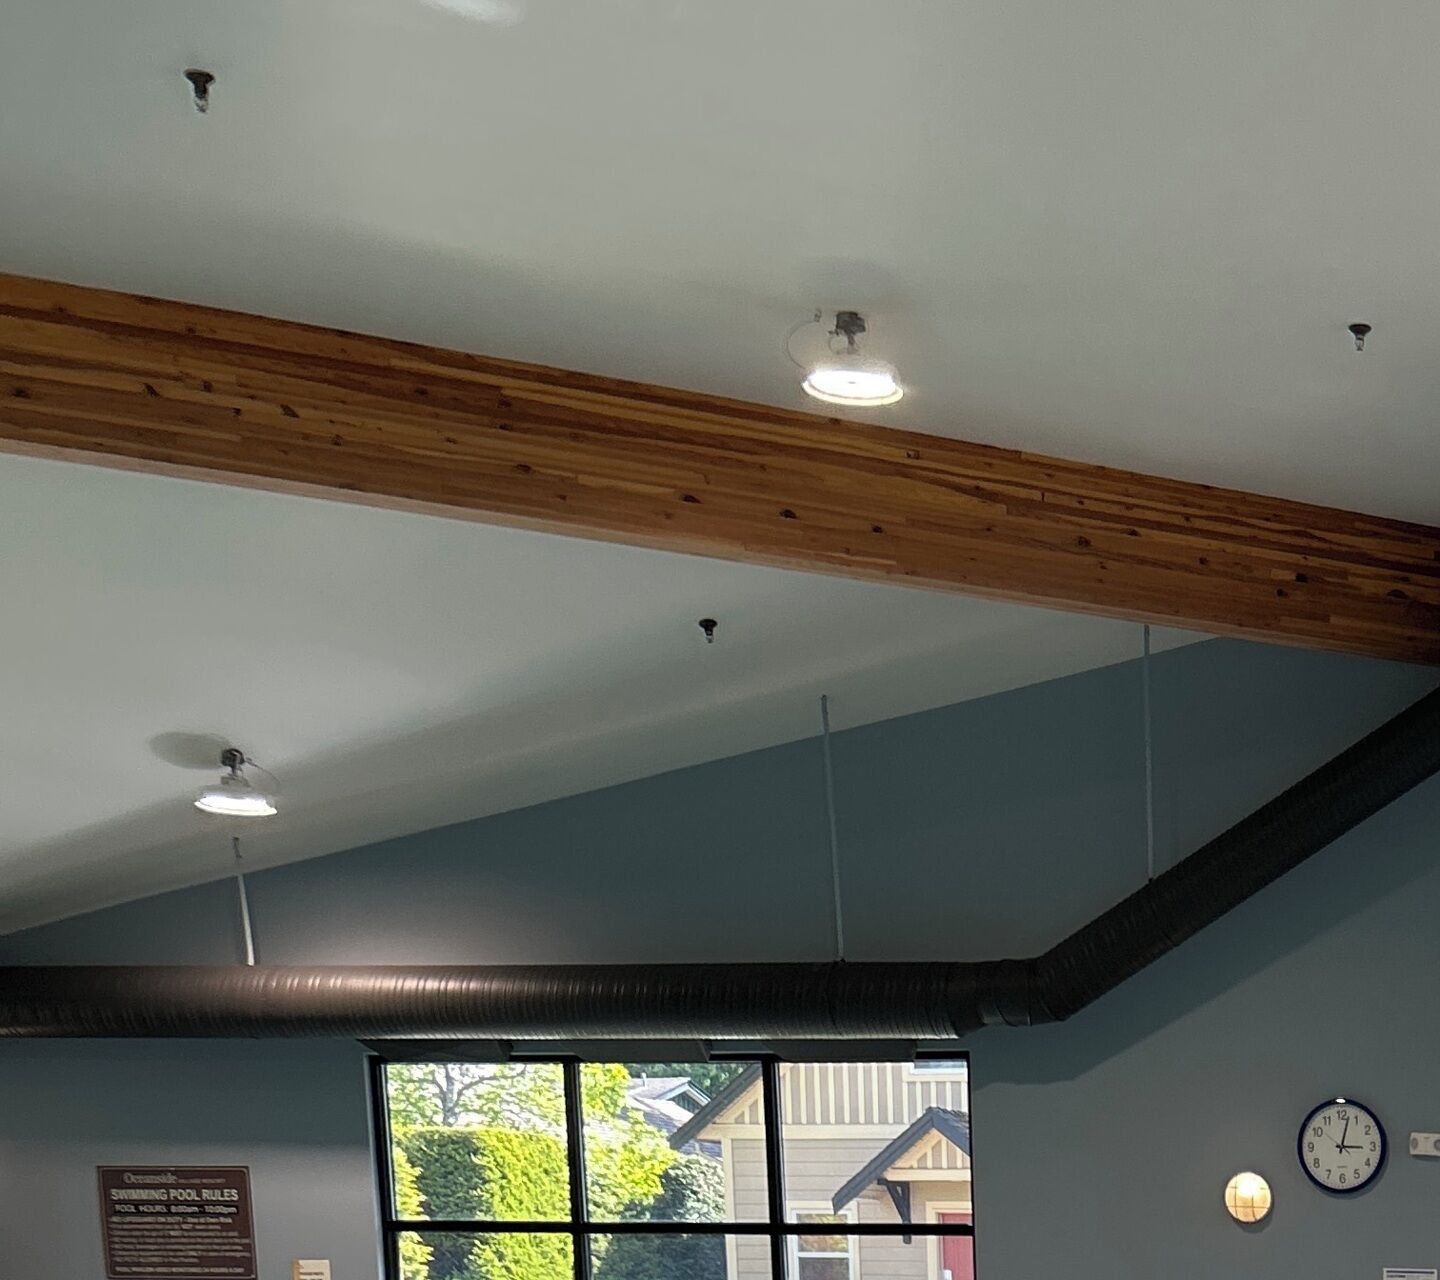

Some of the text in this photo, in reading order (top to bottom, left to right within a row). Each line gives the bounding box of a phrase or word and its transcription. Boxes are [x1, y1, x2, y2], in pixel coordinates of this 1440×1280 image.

[1337, 1109, 1347, 1120] 12
[1322, 1116, 1331, 1126] 11
[1354, 1115, 1358, 1125] 1
[1312, 1126, 1323, 1138] 10
[1364, 1125, 1371, 1135] 2
[1307, 1142, 1314, 1152] 9
[1369, 1141, 1376, 1152] 3
[1313, 1158, 1320, 1168] 8
[1364, 1157, 1371, 1167] 4
[1325, 1169, 1332, 1180] 7
[1339, 1173, 1346, 1184] 6
[1353, 1168, 1360, 1179] 5
[111, 1189, 239, 1200] SWIMMING POOL RULES
[115, 1204, 136, 1212] POOL
